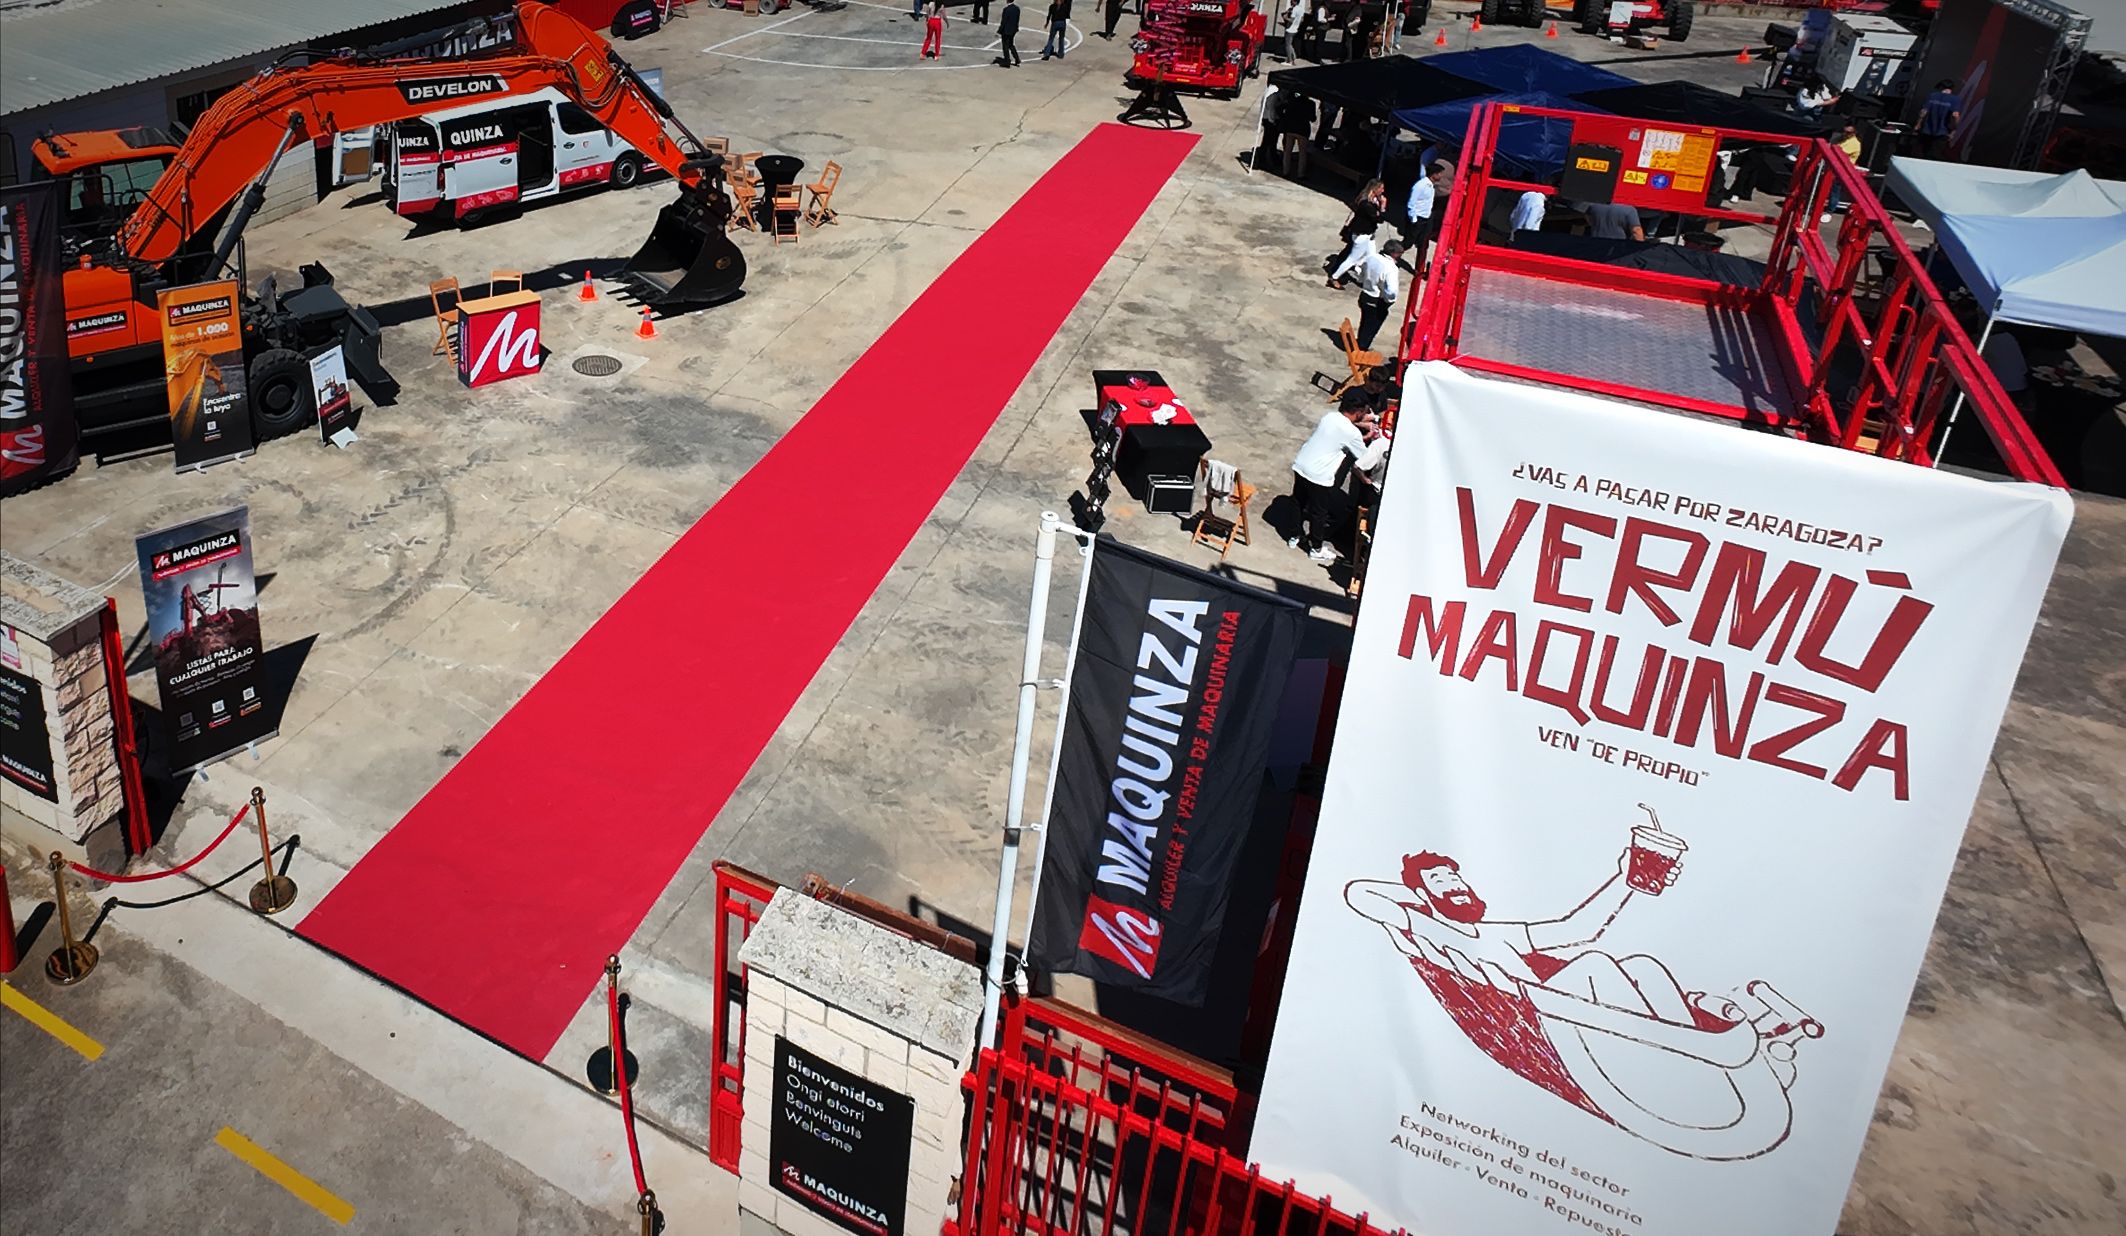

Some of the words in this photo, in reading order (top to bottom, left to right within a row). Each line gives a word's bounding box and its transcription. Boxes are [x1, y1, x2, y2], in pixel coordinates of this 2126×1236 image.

[409, 80, 491, 100] DEVELON
[450, 125, 503, 145] QUINZA
[0, 205, 27, 419] MAQUIN
[197, 322, 229, 337] 1.000
[1573, 475, 1588, 493] A
[1595, 478, 1670, 511] PASAR
[1673, 495, 1721, 523] POR
[1726, 507, 1883, 556] ZARAGOZA?
[172, 534, 237, 562] MAQUINZA
[169, 662, 216, 685] CUALQUIER
[217, 647, 254, 666] TRABAJO
[186, 654, 213, 670] LISTAS
[1196, 611, 1242, 734] MAQUINARIA
[1398, 594, 1910, 802] MAQUINZA
[1097, 599, 1209, 895] MAQUINZA
[1191, 736, 1209, 761] DE
[1538, 726, 1580, 751] VEN
[1177, 766, 1204, 819] VENTA
[1172, 823, 1189, 836] Y
[1159, 839, 1185, 911] ALQUILER
[786, 1073, 823, 1102] Ongi
[827, 1097, 865, 1123] etorri
[788, 1054, 885, 1112] Bienvenidos
[785, 1107, 853, 1153] Welcome
[786, 1090, 862, 1140] Benvinguts
[1400, 1114, 1494, 1162] Exposición
[1500, 1157, 1525, 1175] de
[1530, 1171, 1643, 1226] maquinaria
[1421, 1101, 1530, 1158] Networking
[1536, 1150, 1567, 1170] del
[1571, 1165, 1631, 1197] sector
[804, 1174, 889, 1226] MAQUINZA
[1390, 1133, 1462, 1170] Alquiler
[1475, 1165, 1528, 1199] Venta
[1544, 1195, 1631, 1236] Repuest
